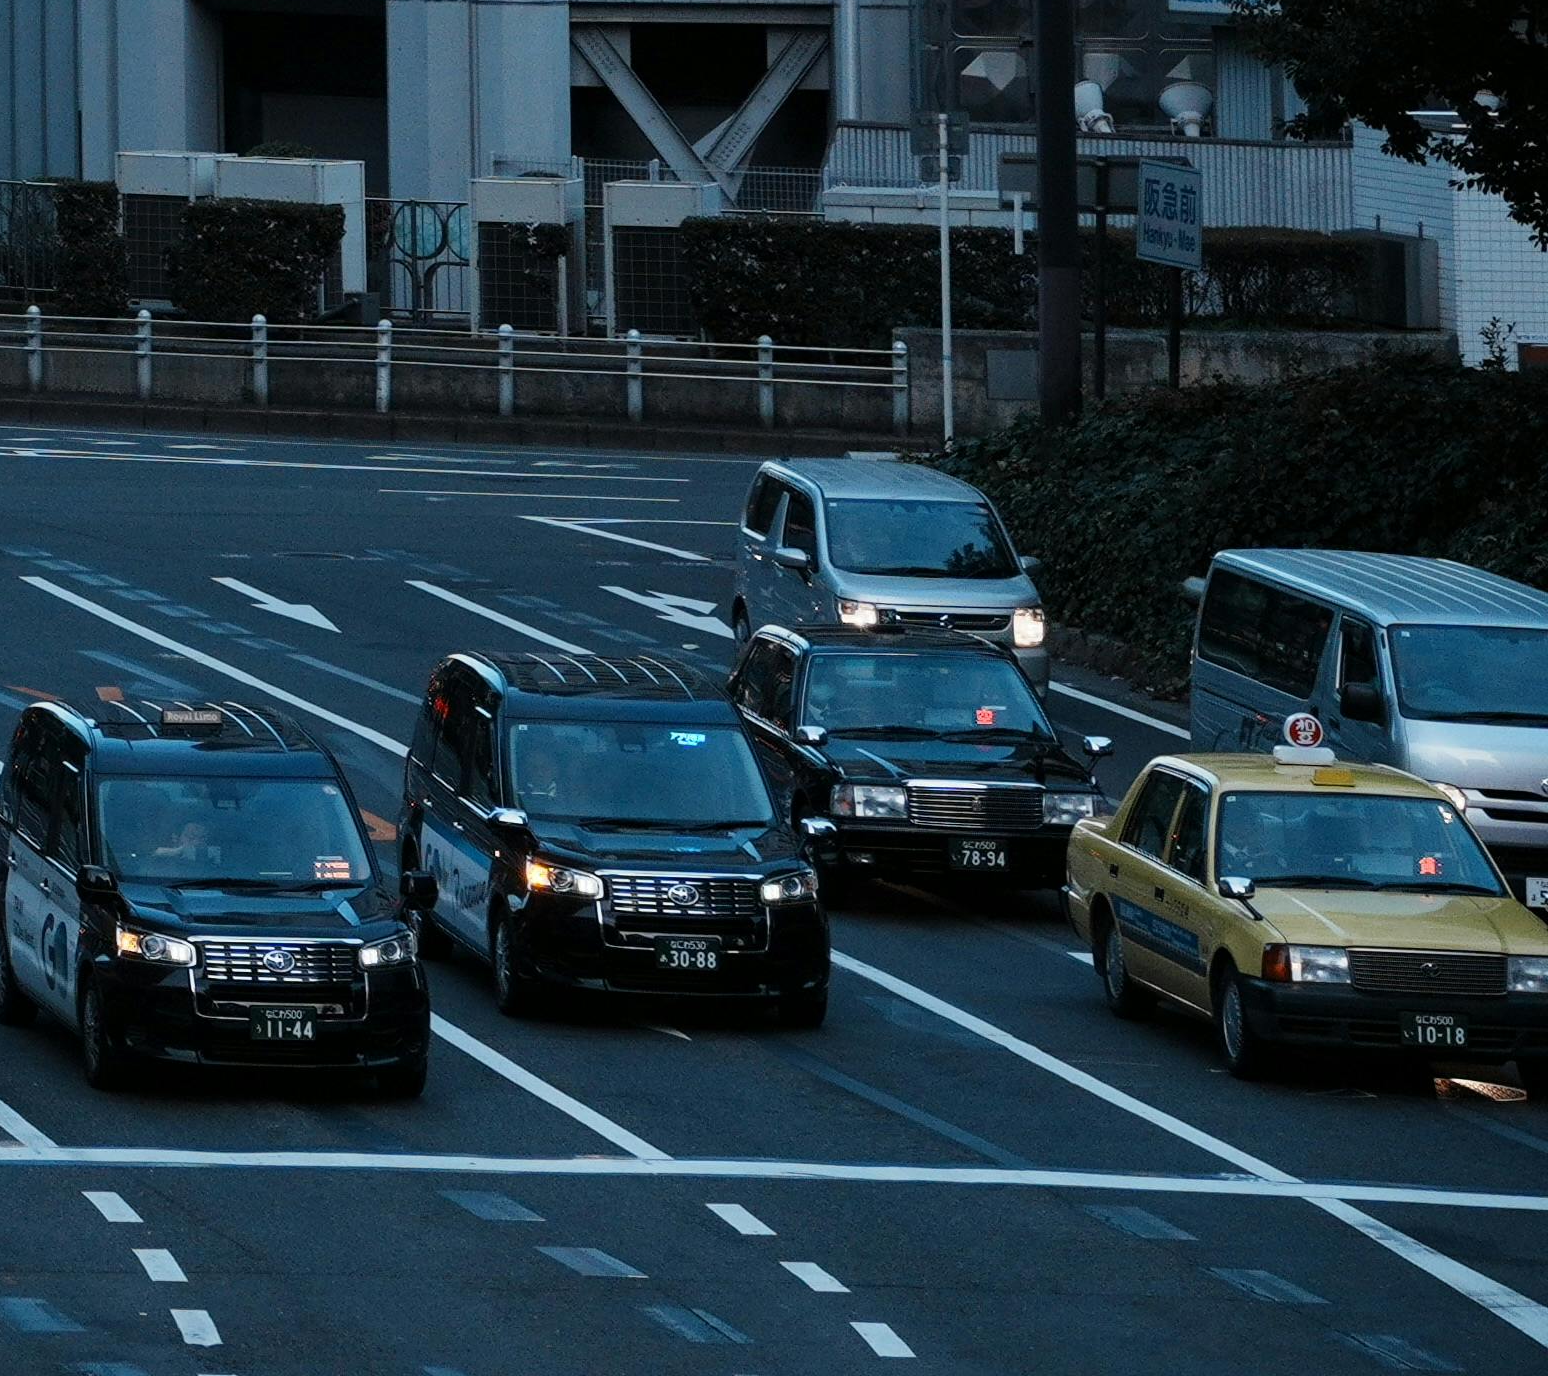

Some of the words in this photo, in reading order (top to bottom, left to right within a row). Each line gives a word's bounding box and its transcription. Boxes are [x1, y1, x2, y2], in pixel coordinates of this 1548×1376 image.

[1144, 177, 1197, 225] 阪急前
[961, 850, 1006, 867] 78-94
[669, 950, 717, 969] 30-88
[266, 1020, 314, 1039] 11-44
[1416, 1026, 1465, 1045] 10-18
